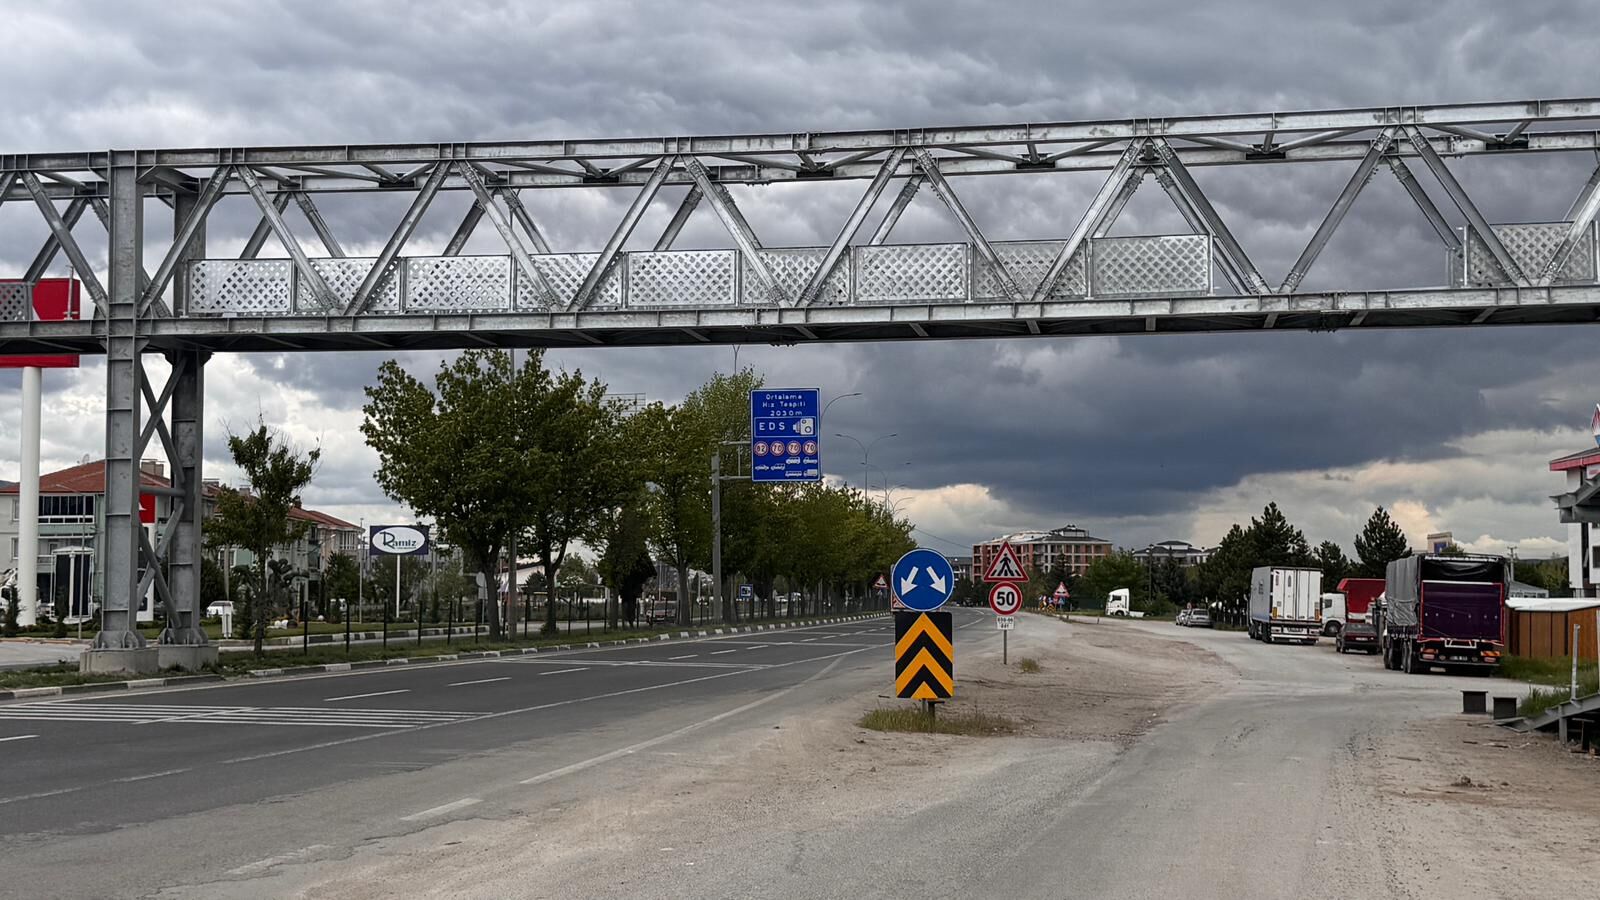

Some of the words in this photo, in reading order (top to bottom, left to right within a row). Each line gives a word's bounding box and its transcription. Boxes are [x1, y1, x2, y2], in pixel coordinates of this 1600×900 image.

[759, 422, 785, 430] EDS
[379, 531, 417, 549] Ramiz
[996, 592, 1015, 606] 50
